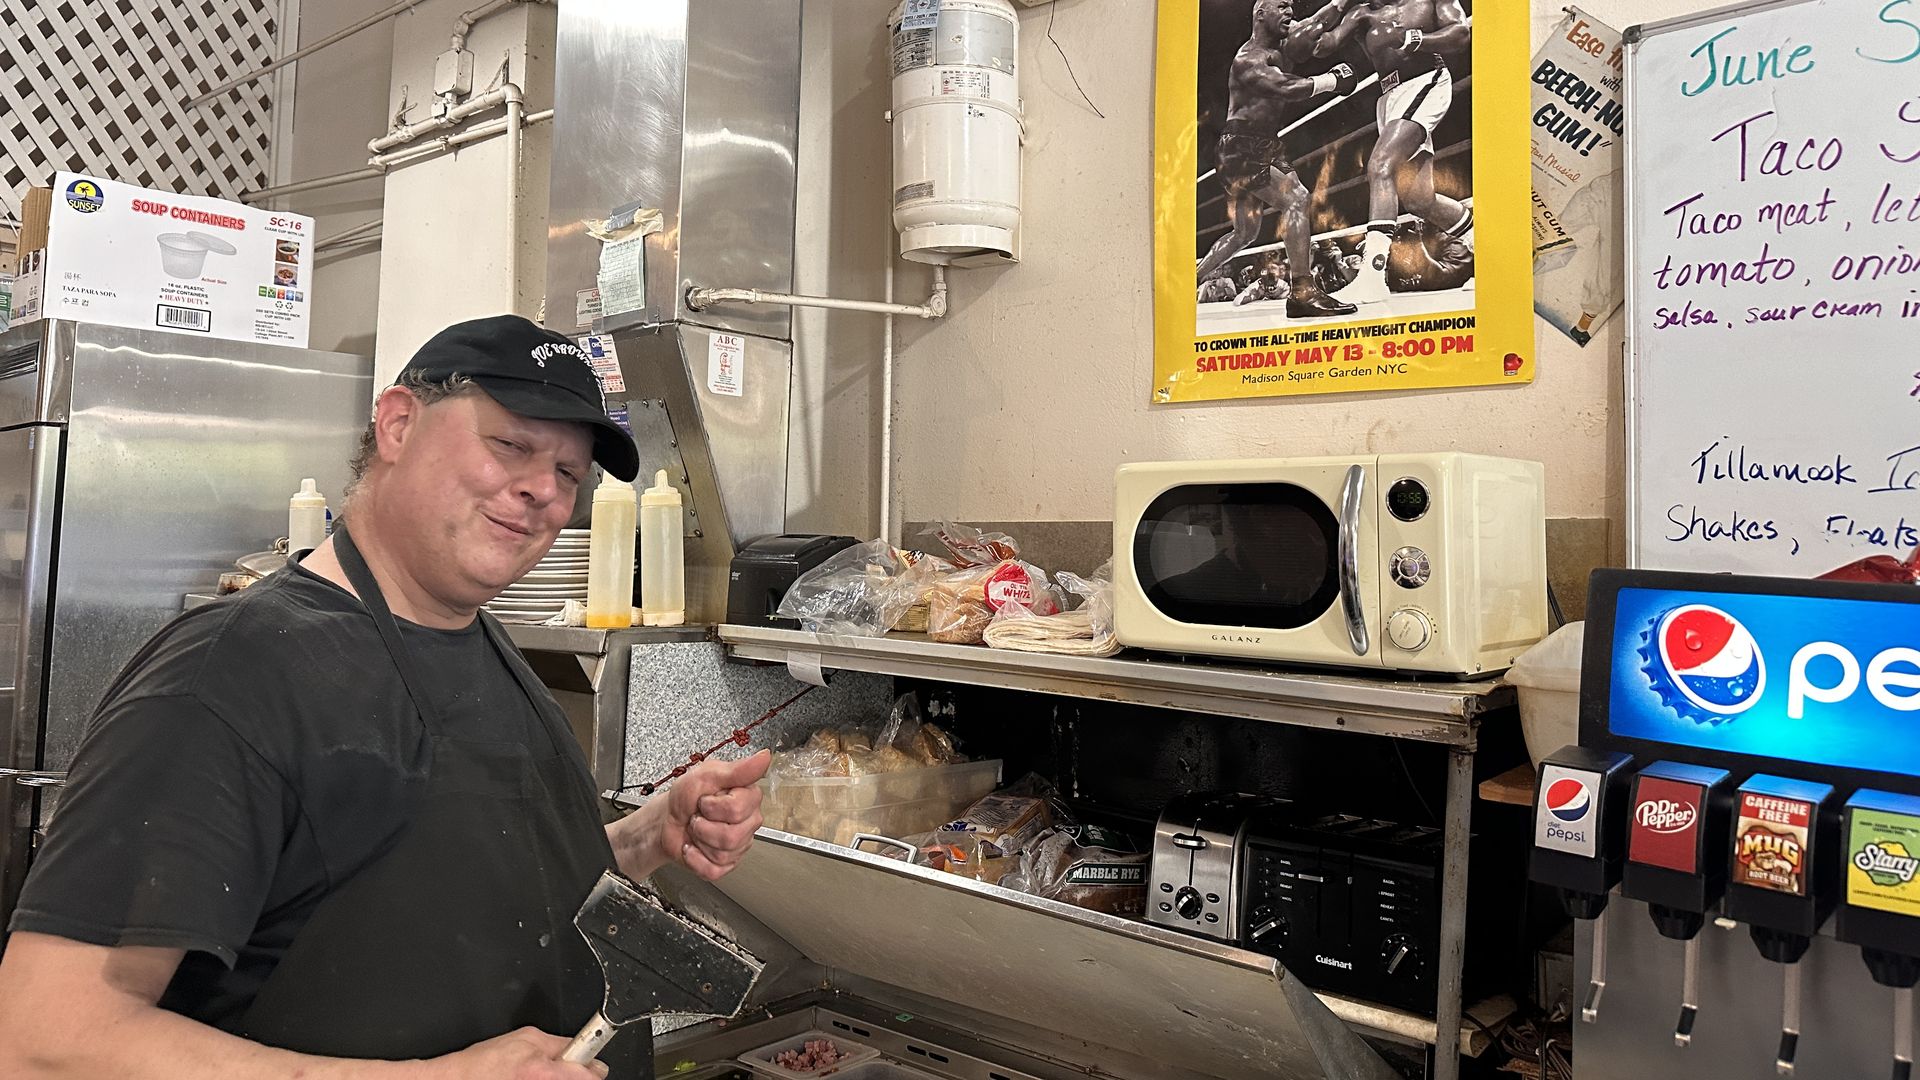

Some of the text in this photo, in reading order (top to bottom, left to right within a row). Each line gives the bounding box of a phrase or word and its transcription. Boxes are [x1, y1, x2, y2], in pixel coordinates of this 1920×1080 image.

[1566, 19, 1605, 60] Ease
[1681, 26, 1815, 97] June
[1599, 74, 1622, 93] with
[1711, 110, 1843, 182] Taco
[1543, 152, 1581, 183] Musial
[68, 199, 101, 213] SUNSET
[131, 198, 246, 231] SOUP CONTAINERS
[1663, 192, 1742, 239] Taco
[269, 216, 302, 230] SC-16
[1543, 210, 1566, 237] GUM
[62, 285, 117, 298] TAZA PARA SOPA
[165, 294, 206, 305] HEAVY DUTY
[176, 290, 210, 298] CONTAINERS
[1745, 304, 1809, 325] sour
[1811, 300, 1882, 319] cream
[1194, 316, 1476, 353] TO CROWN THE ALL-TIME HEAVYWEIGHT CHAMPION
[531, 342, 554, 368] JOE
[1196, 350, 1291, 373] SATURDAY
[1295, 345, 1338, 365] MAY
[1342, 343, 1364, 362] 13
[1382, 338, 1435, 358] 8:00
[1440, 334, 1474, 354] PM
[1242, 363, 1408, 384] Madison Square Garden NYC
[1691, 435, 1857, 485] Tillamook
[1003, 587, 1031, 599] WHITE
[1211, 634, 1262, 645] GALANZ
[1787, 641, 1920, 719] pe
[1642, 800, 1692, 828] Pepper
[1658, 800, 1679, 814] Dr
[1745, 796, 1809, 816] CAFFEINE
[1758, 808, 1790, 824] FREE
[1546, 828, 1584, 842] pepsi
[1547, 821, 1561, 829] diet
[1743, 834, 1799, 866] MUG
[1854, 843, 1918, 882] Starry
[1072, 867, 1140, 880] MARBLE RYE
[1749, 871, 1790, 885] ROOT BEER
[1315, 954, 1352, 970] Cuisinart
